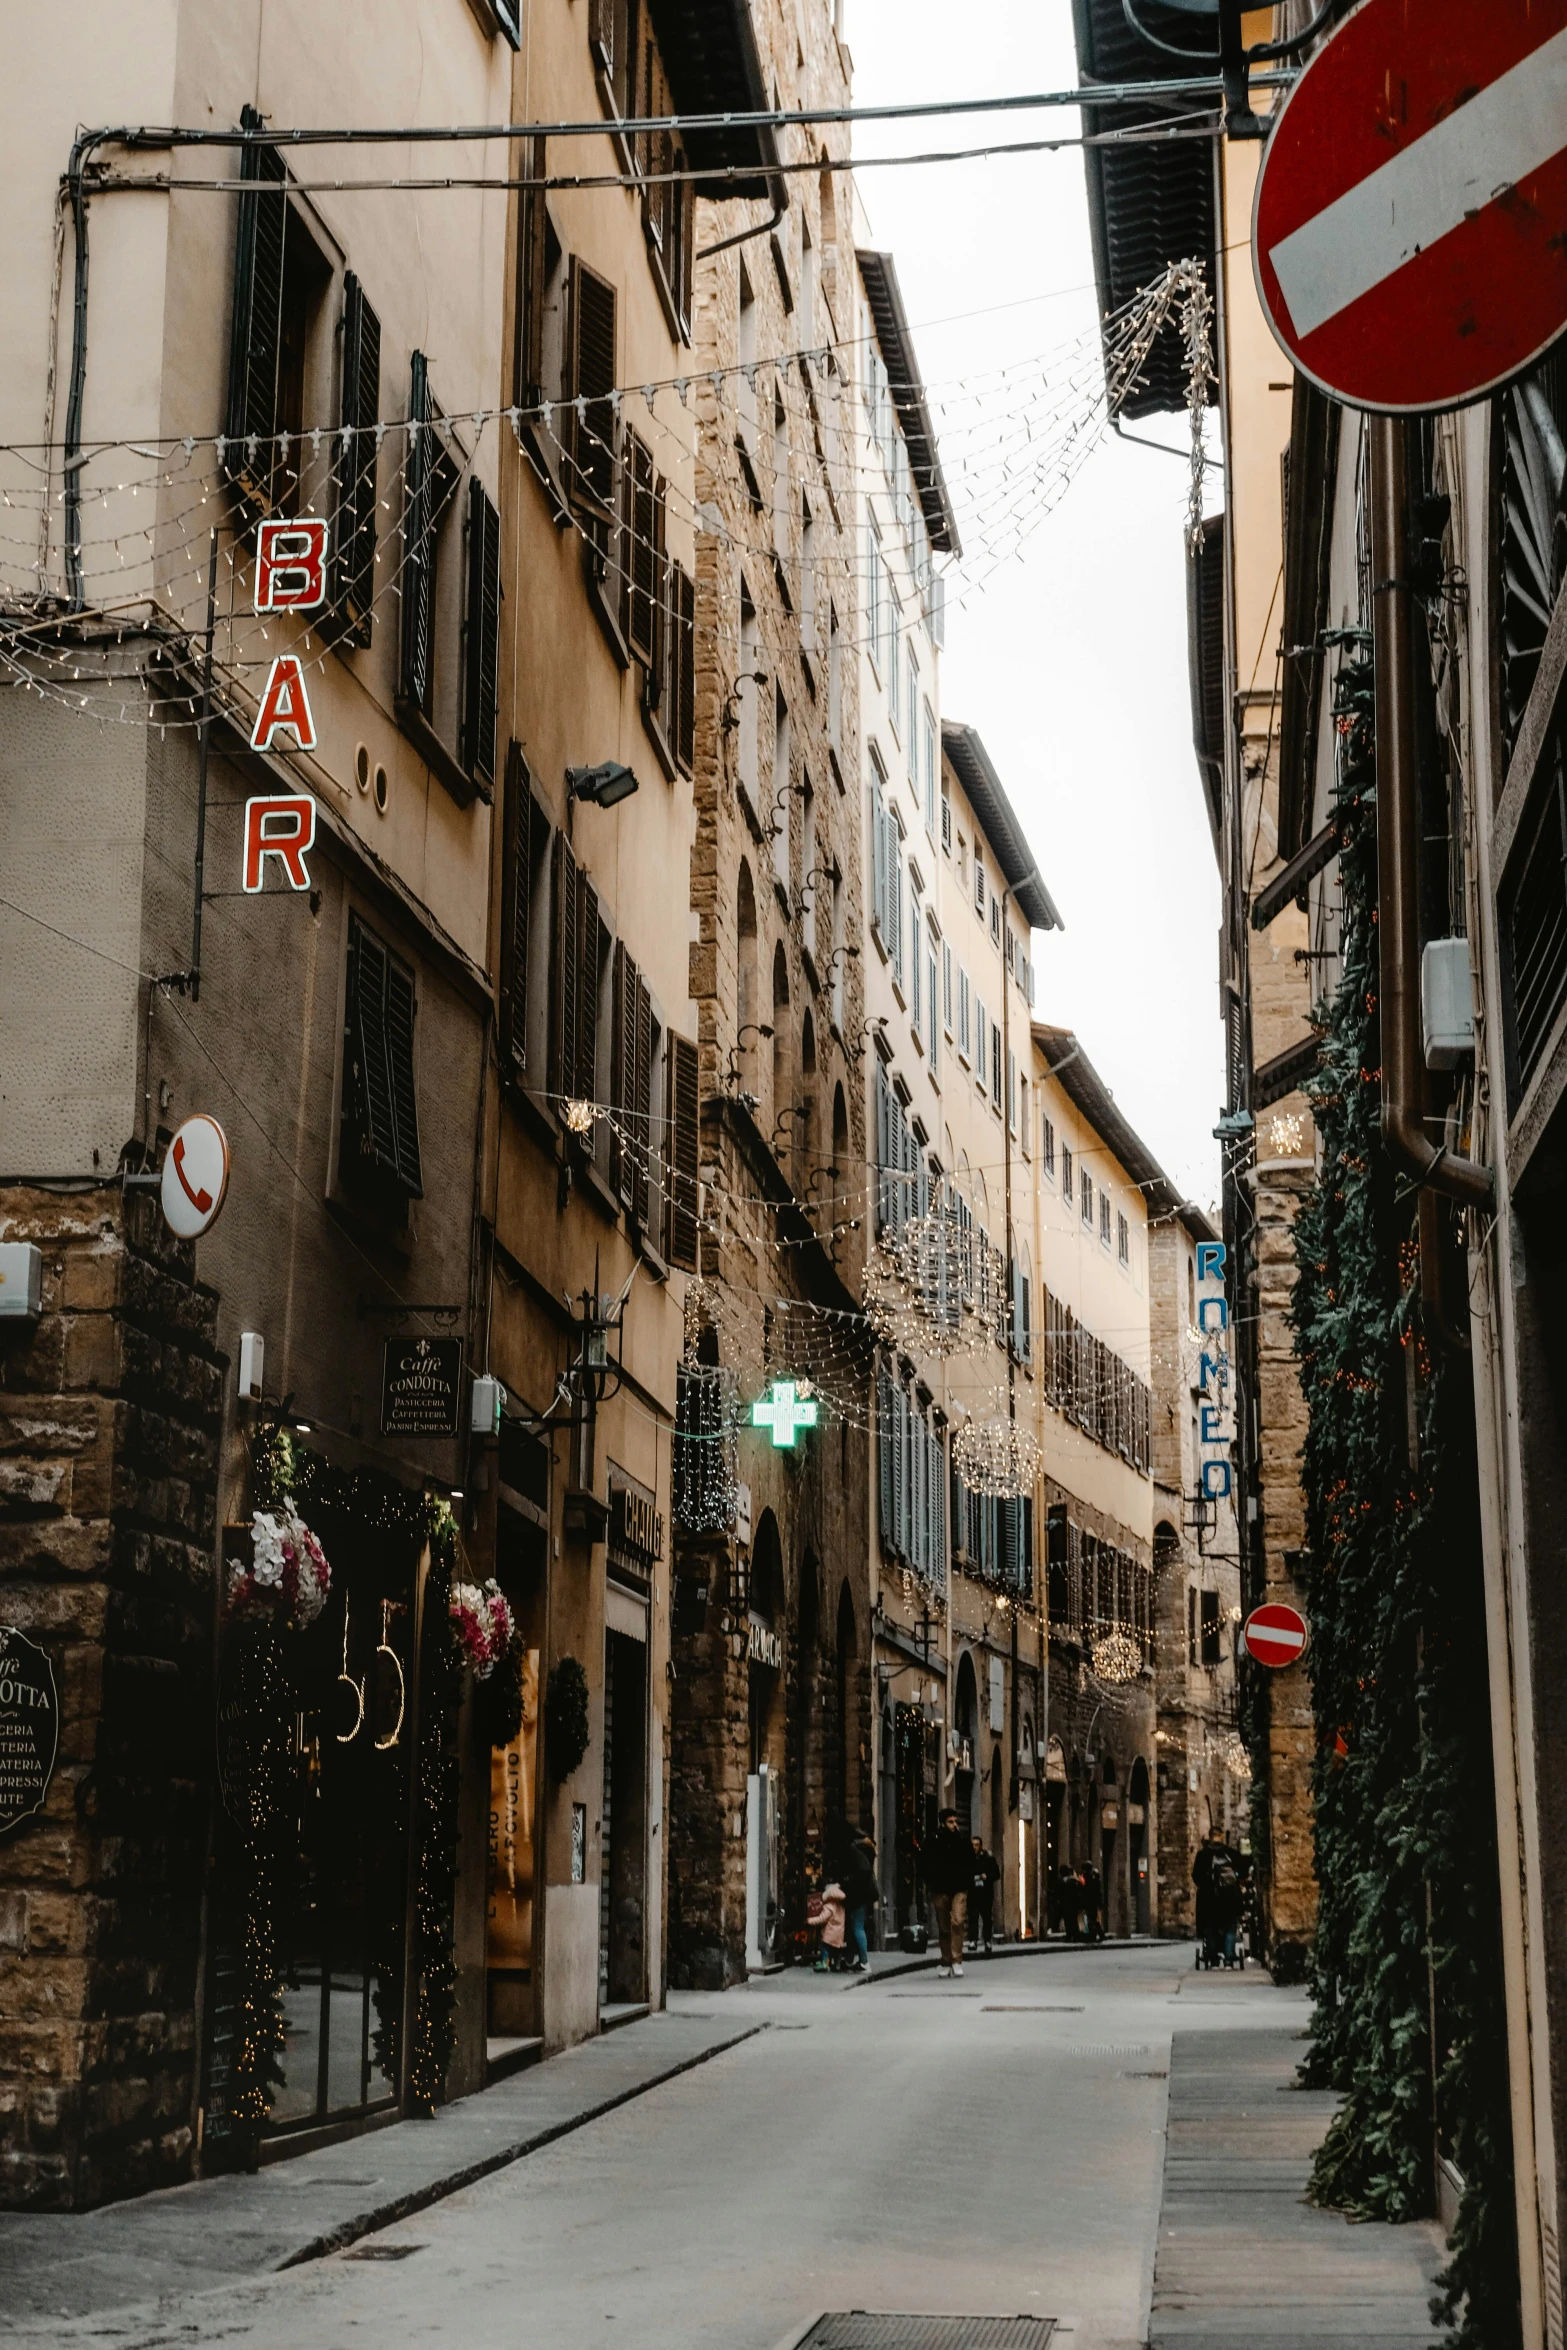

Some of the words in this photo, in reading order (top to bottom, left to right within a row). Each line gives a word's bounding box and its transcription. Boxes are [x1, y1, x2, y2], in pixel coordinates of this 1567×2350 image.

[243, 518, 328, 894] BAR
[390, 1375, 451, 1394] CONDOTTA
[400, 1357, 442, 1375] Caffè
[1196, 1240, 1231, 1498] ROMEO
[748, 1622, 782, 1669] ARMACIA
